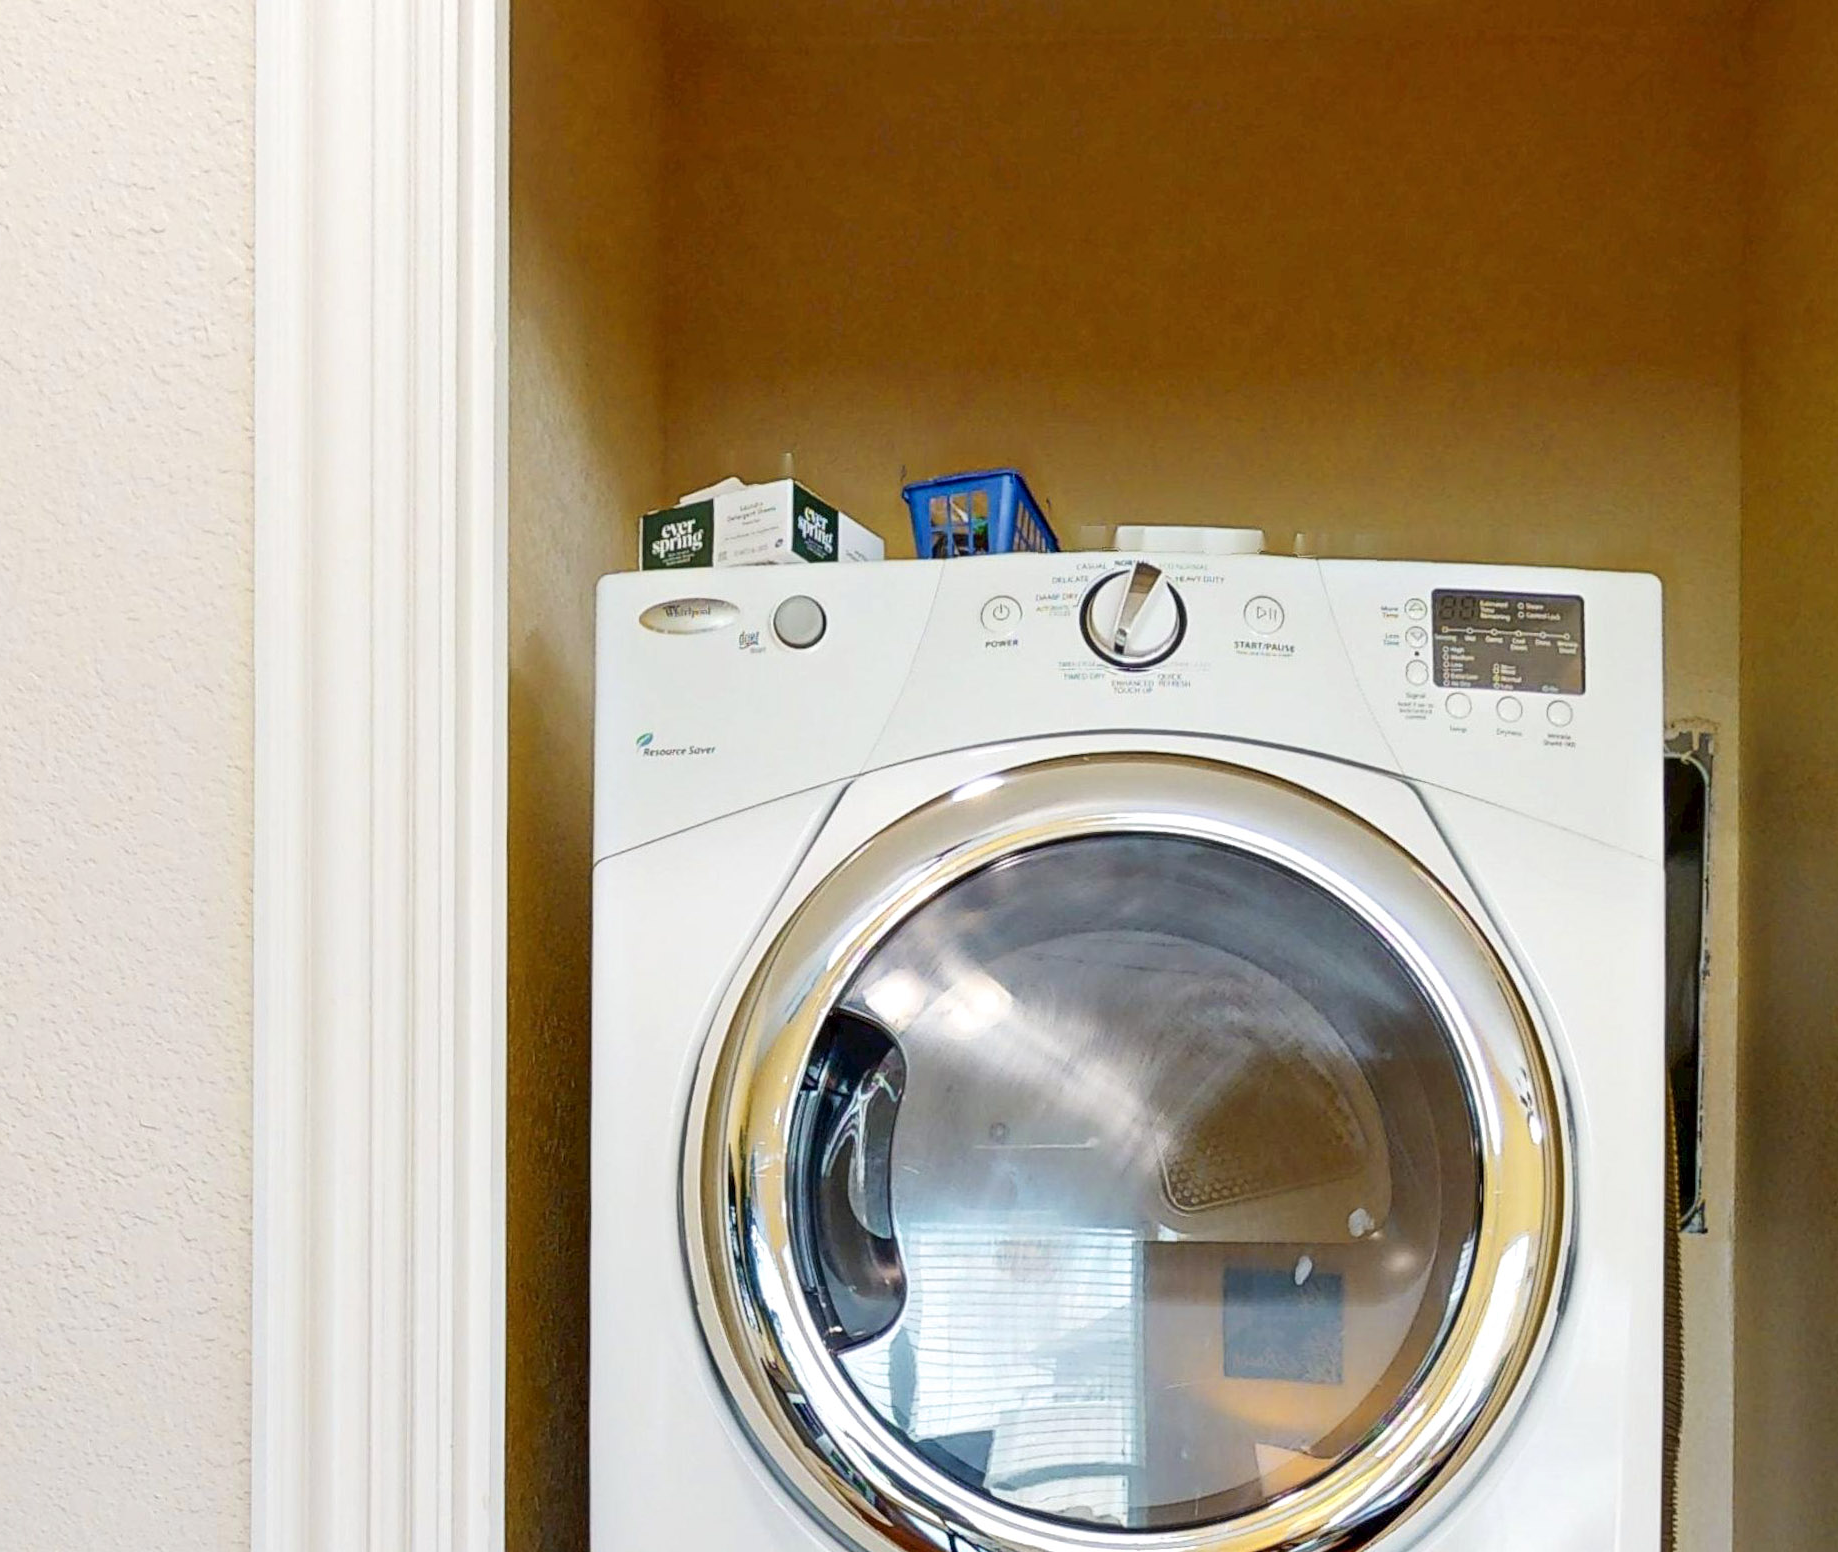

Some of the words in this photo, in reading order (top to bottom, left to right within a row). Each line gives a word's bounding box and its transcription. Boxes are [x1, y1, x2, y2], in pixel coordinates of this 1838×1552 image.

[804, 506, 829, 531] ever
[661, 518, 697, 539] ever
[797, 515, 834, 554] spring
[651, 528, 705, 559] spring
[1052, 576, 1089, 585] DELICATE
[663, 604, 712, 619] Whirlpool
[985, 639, 1019, 648] POWER
[1233, 640, 1295, 652] START/PAUSE
[643, 747, 687, 757] Resource
[688, 745, 716, 755] Saver
